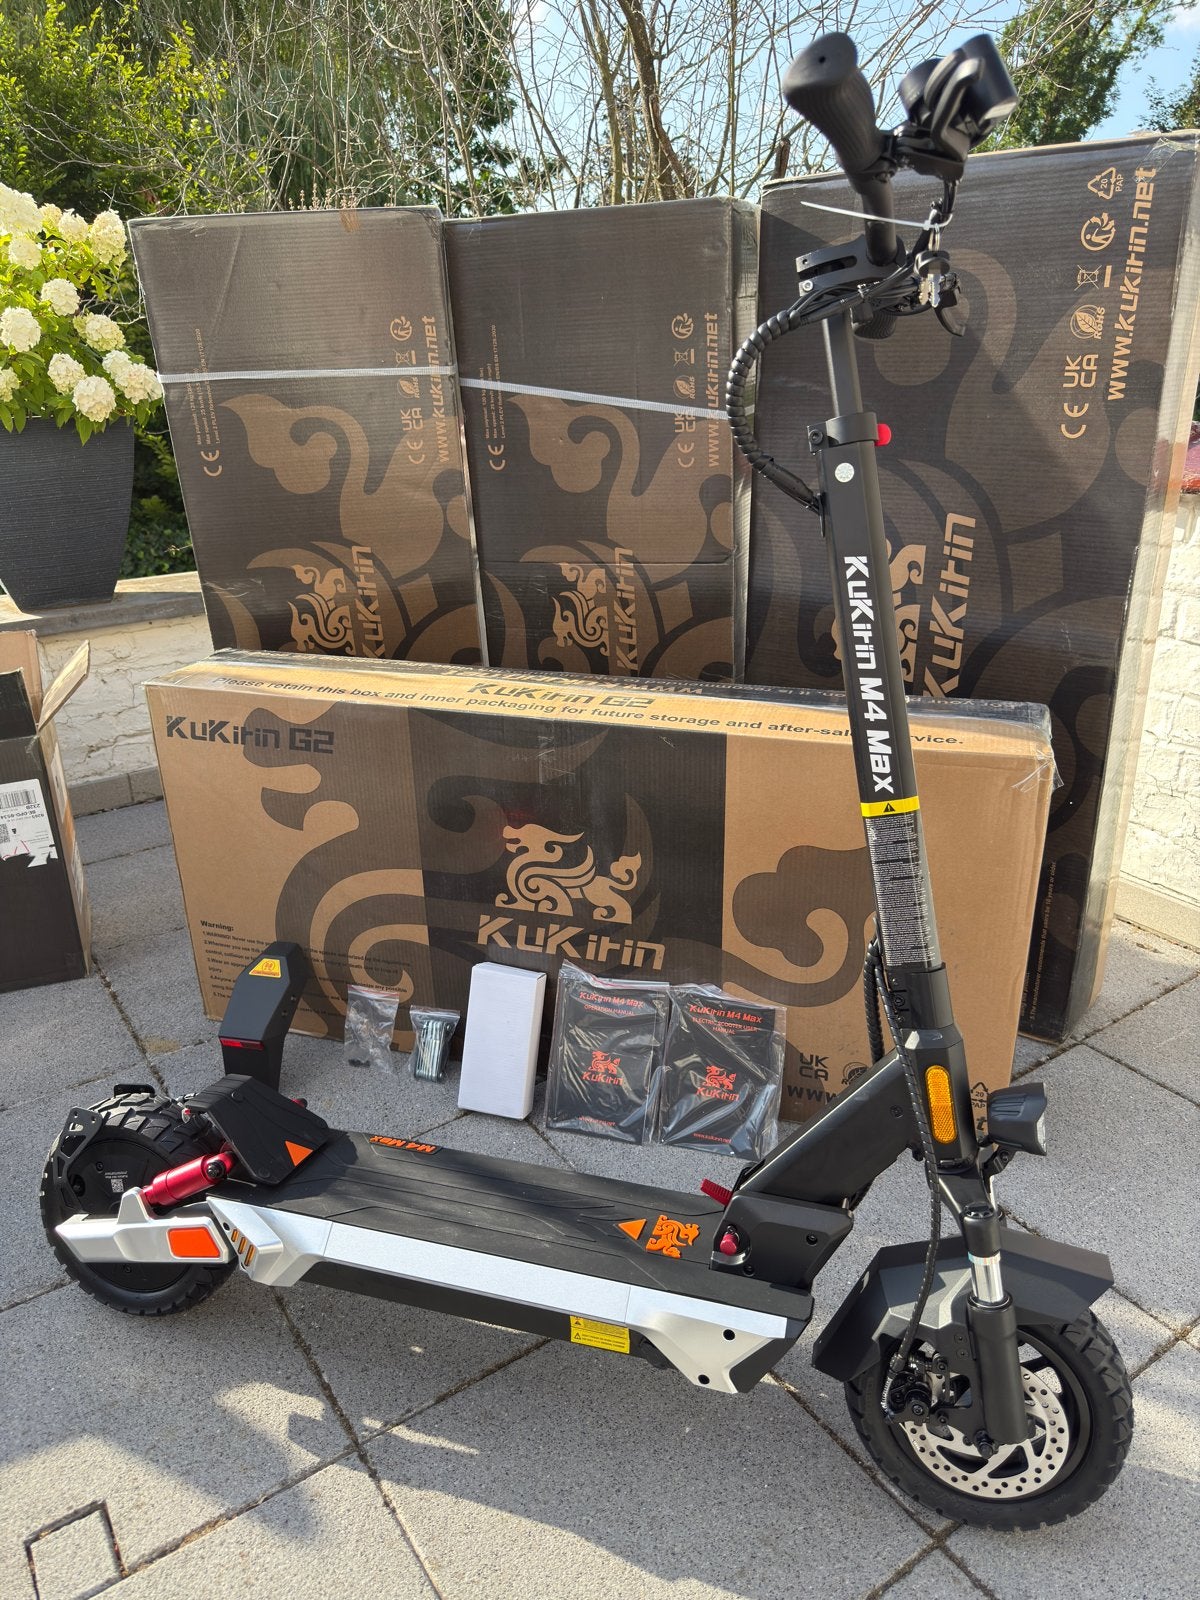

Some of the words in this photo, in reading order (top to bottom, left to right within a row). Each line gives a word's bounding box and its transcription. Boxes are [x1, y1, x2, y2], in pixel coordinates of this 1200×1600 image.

[1099, 178, 1108, 189] 20
[1114, 173, 1125, 191] PAP
[1106, 167, 1157, 400] www.kukirin.net
[1093, 305, 1106, 339] RoHS
[1062, 355, 1082, 388] UK
[1080, 353, 1098, 389] CA
[399, 409, 412, 431] UK
[410, 408, 424, 430] CA
[201, 450, 223, 477] CE
[487, 444, 506, 471] CE
[843, 555, 877, 670] KuKirin
[212, 677, 262, 688] Please
[267, 680, 313, 692] retain
[316, 685, 346, 695] this
[350, 688, 382, 698] box
[385, 692, 417, 701] and
[419, 694, 463, 704] inner
[465, 697, 557, 714] packaging
[560, 704, 587, 715] for
[590, 707, 645, 720] future
[649, 713, 721, 727] storage
[725, 720, 762, 730] and
[599, 694, 657, 709] G2
[858, 676, 887, 721] M4
[166, 715, 281, 750] KuKirin
[289, 726, 335, 755] G2
[865, 729, 895, 794] Max
[200, 919, 234, 932] Warning:
[477, 914, 665, 970] KuKirin
[612, 996, 626, 1006] M4
[627, 998, 644, 1009] Max
[688, 1003, 727, 1017] KuKirin
[727, 1010, 741, 1020] M4
[742, 1012, 764, 1024] Max
[798, 1065, 829, 1082] CA
[799, 1052, 830, 1069] UK
